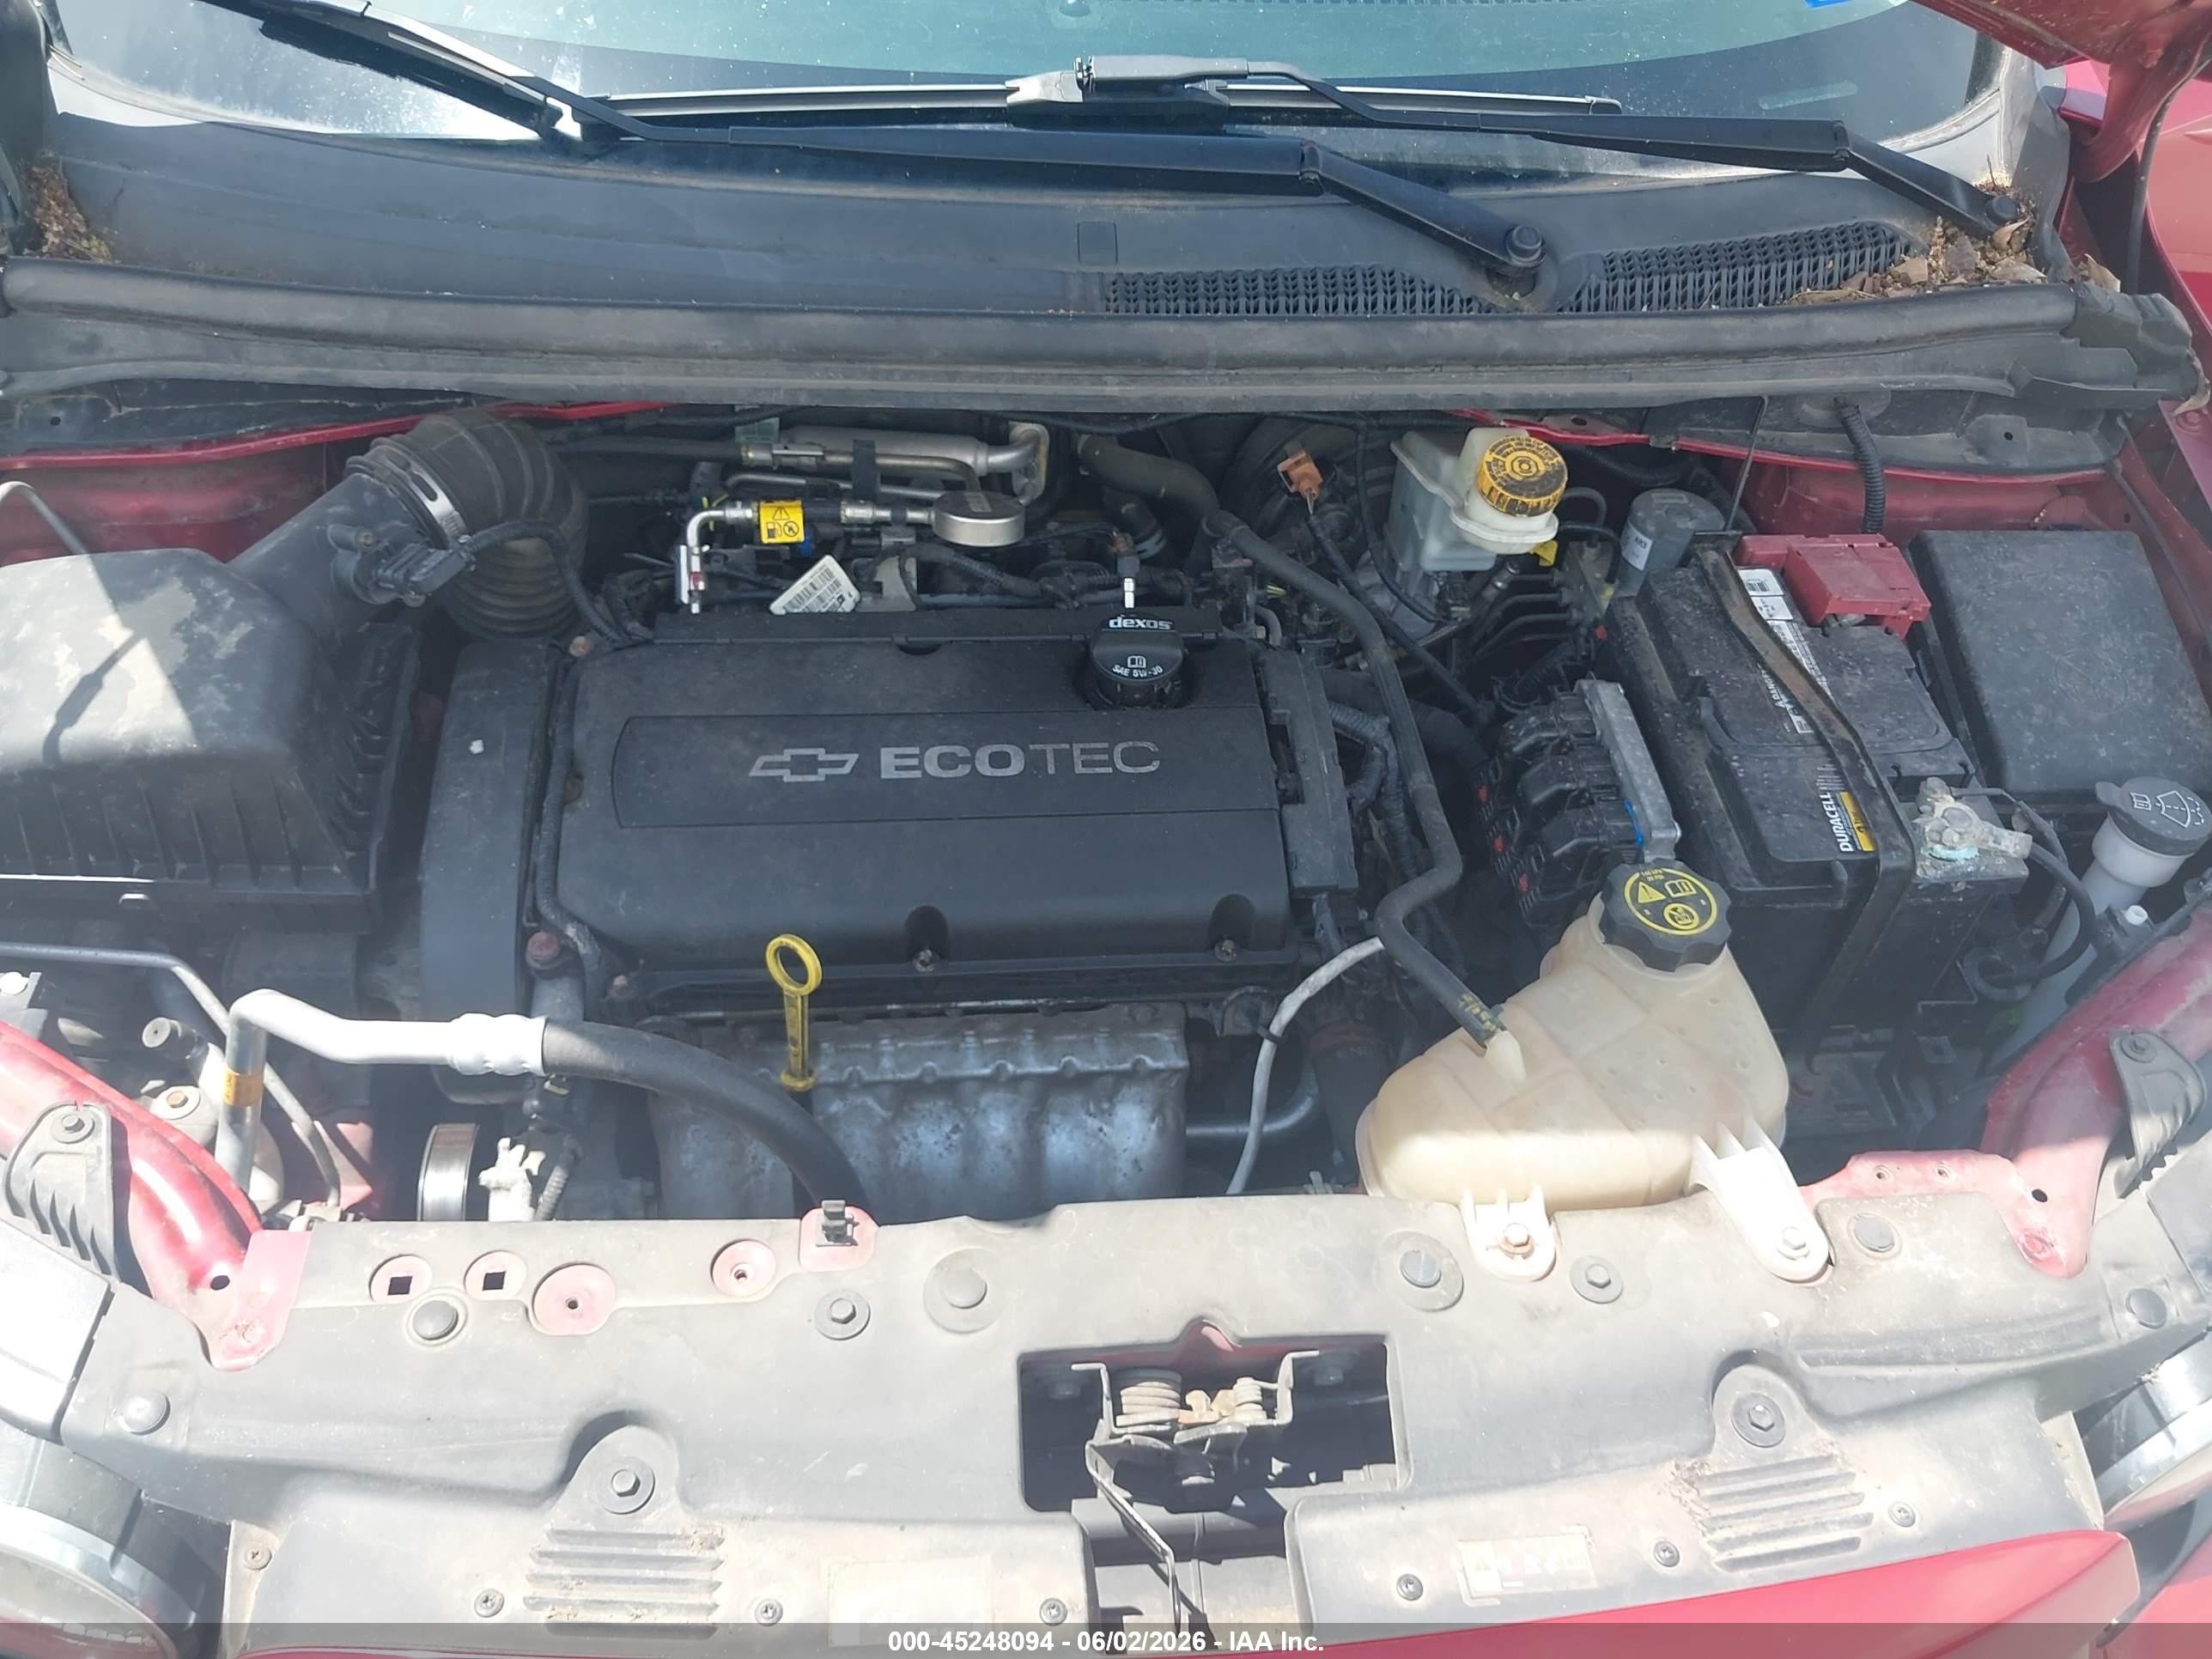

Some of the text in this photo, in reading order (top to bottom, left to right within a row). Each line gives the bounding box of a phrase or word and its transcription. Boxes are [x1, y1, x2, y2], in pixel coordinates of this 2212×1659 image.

[1109, 616, 1173, 629] dexos
[1112, 665, 1163, 678] SAE 5W-30
[880, 741, 1160, 780] ECOTEC
[1819, 792, 1855, 852] DURACELL
